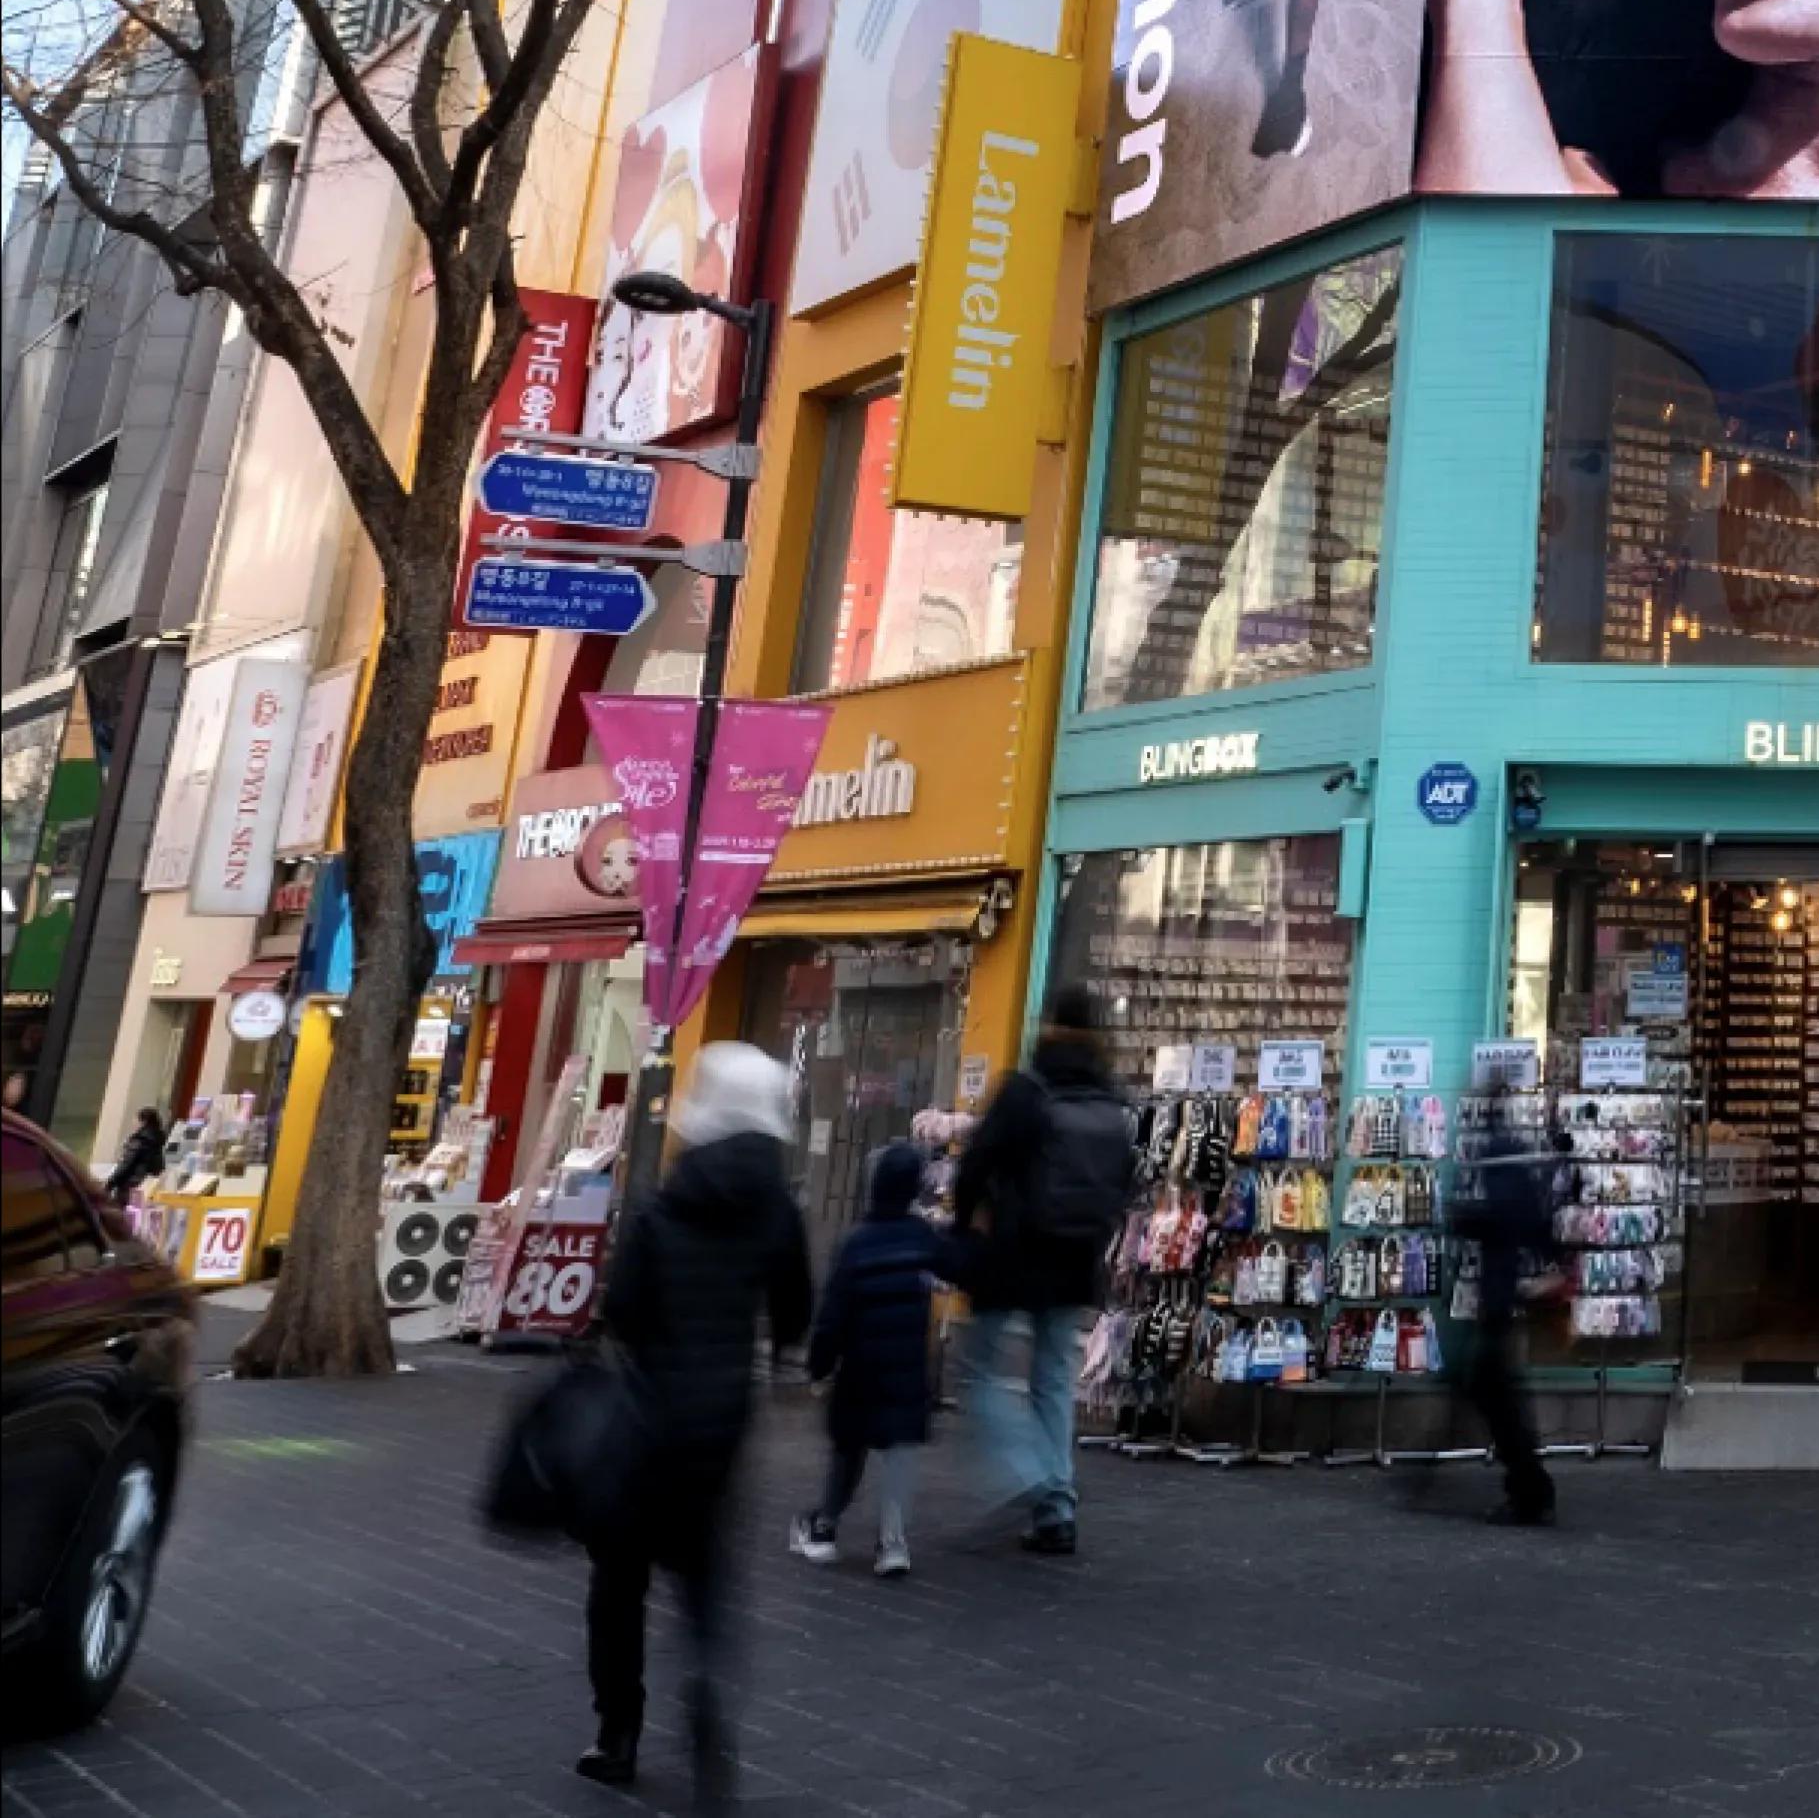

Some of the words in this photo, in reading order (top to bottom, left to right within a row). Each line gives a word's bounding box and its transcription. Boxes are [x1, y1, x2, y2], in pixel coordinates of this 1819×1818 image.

[948, 130, 1040, 411] Lamelin
[237, 739, 273, 816] ROYAL
[792, 732, 916, 829] melin
[1140, 732, 1260, 783] BLINGBOX
[1425, 782, 1471, 804] ADT
[222, 827, 254, 891] SKIN
[203, 1216, 245, 1254] 70
[525, 1233, 597, 1259] SALE
[505, 1261, 596, 1316] 80
